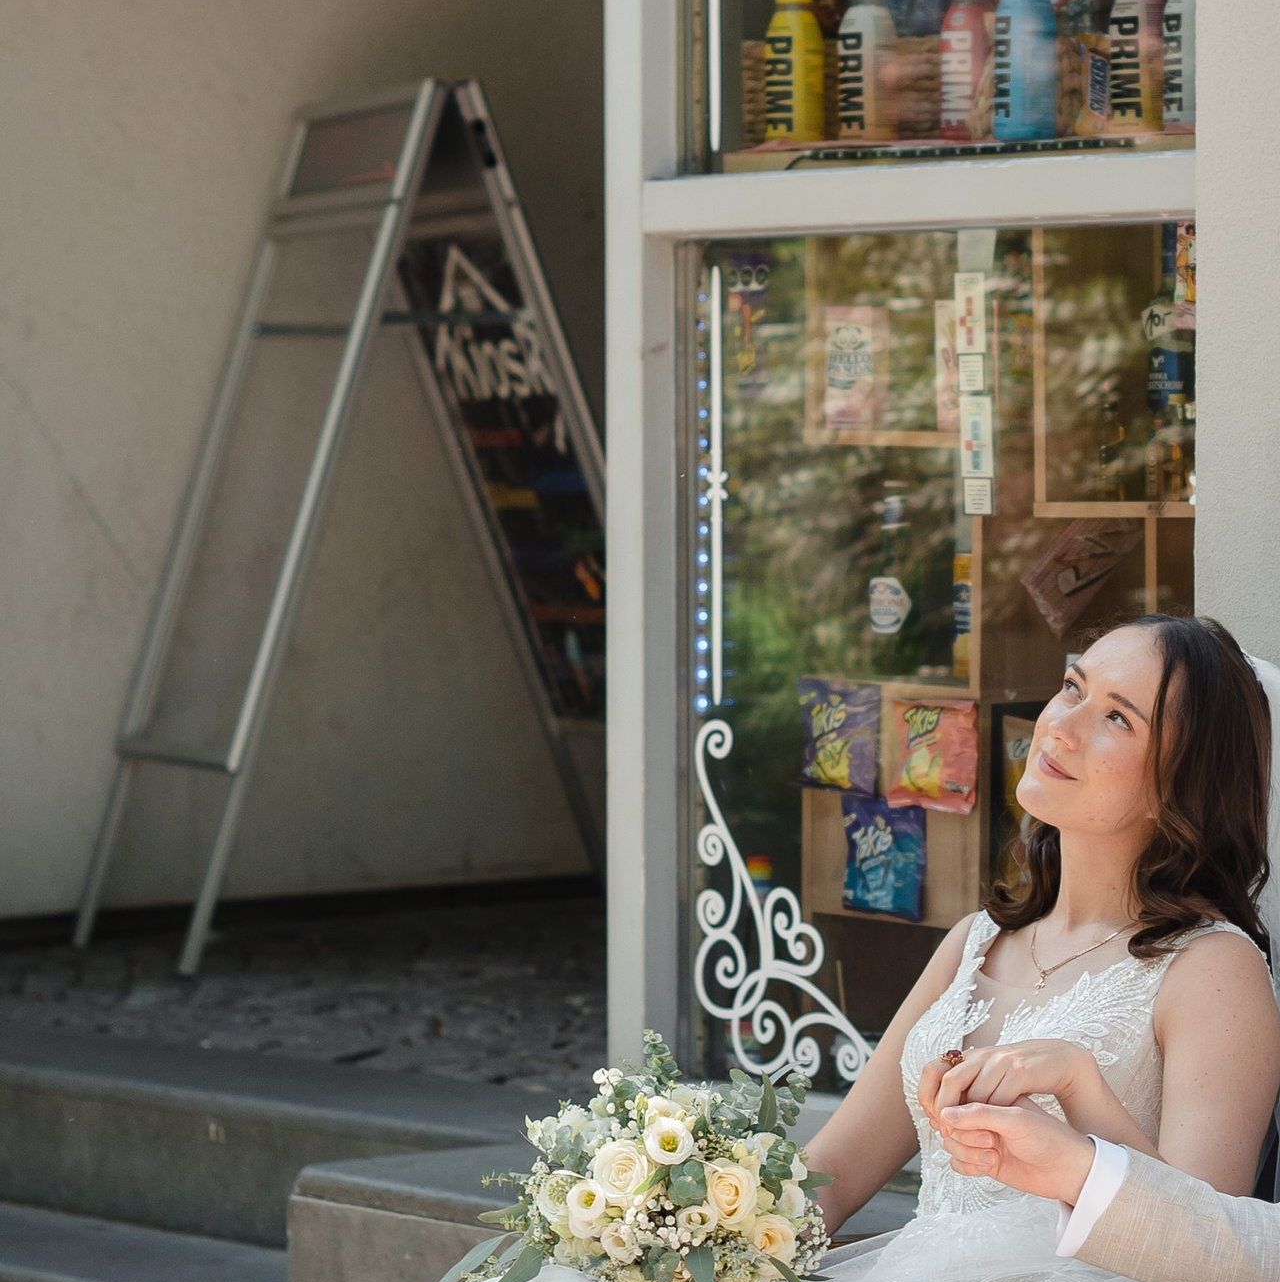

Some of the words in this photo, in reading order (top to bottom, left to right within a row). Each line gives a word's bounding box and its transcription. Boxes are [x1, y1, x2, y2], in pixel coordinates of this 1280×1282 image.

[766, 35, 793, 133] PRIME
[838, 31, 865, 131] PRIME
[941, 30, 972, 128] PRIME
[1110, 16, 1143, 119] PRIME
